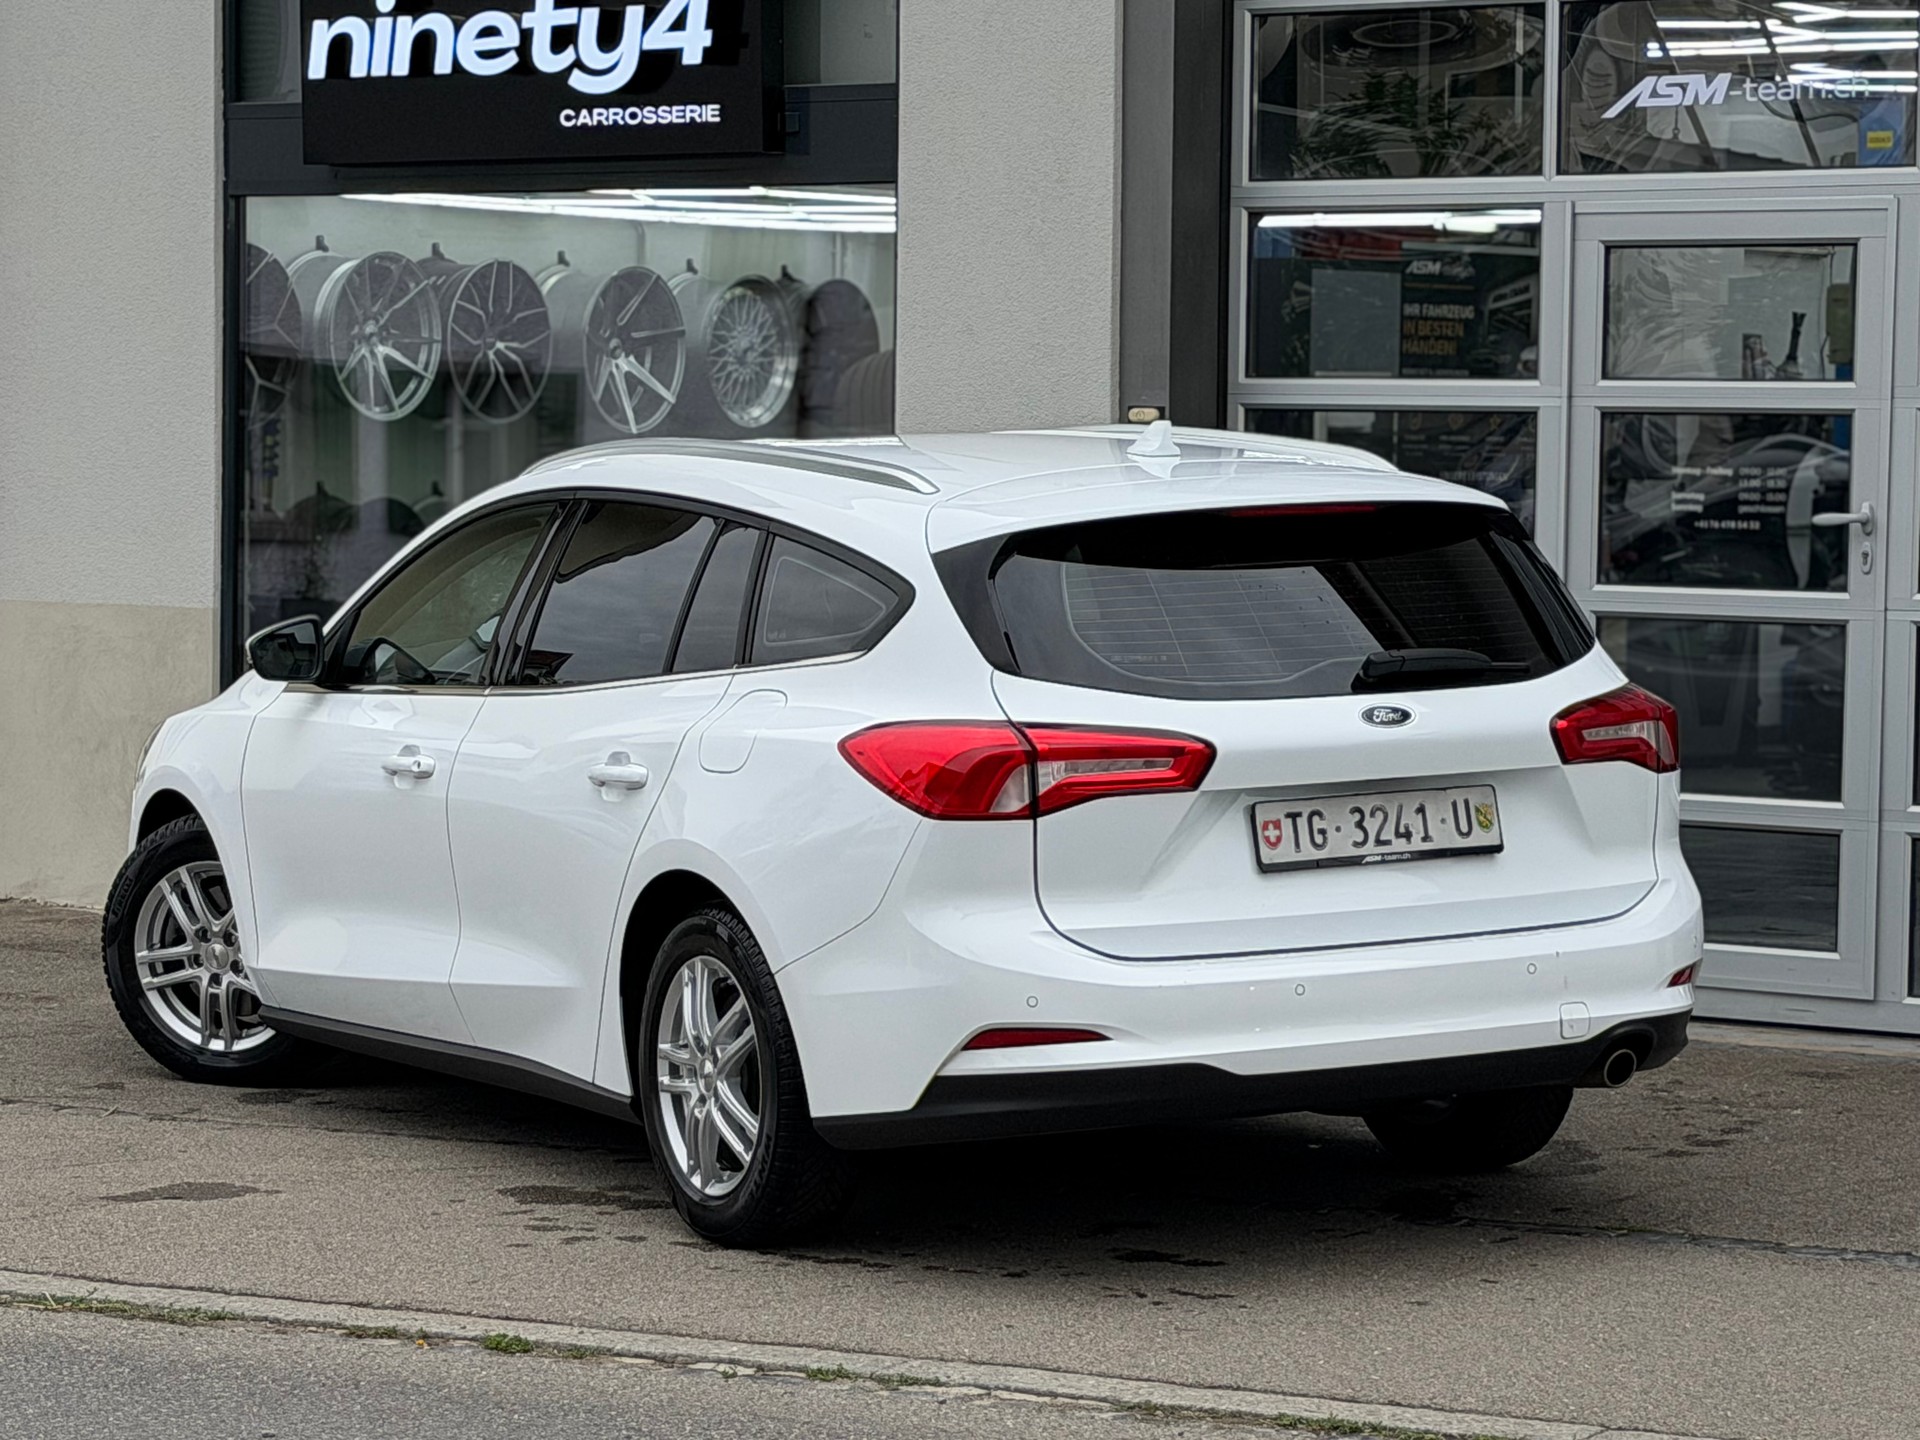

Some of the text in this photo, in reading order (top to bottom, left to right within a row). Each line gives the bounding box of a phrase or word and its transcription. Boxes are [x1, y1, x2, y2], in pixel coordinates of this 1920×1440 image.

[307, 0, 713, 95] ninety4
[1601, 66, 1870, 119] ASM-team.ch
[559, 104, 722, 128] CARROSSERIE
[1422, 303, 1476, 320] FAHRZEUG
[1417, 320, 1465, 337] BESTEN
[1372, 708, 1404, 723] Ford
